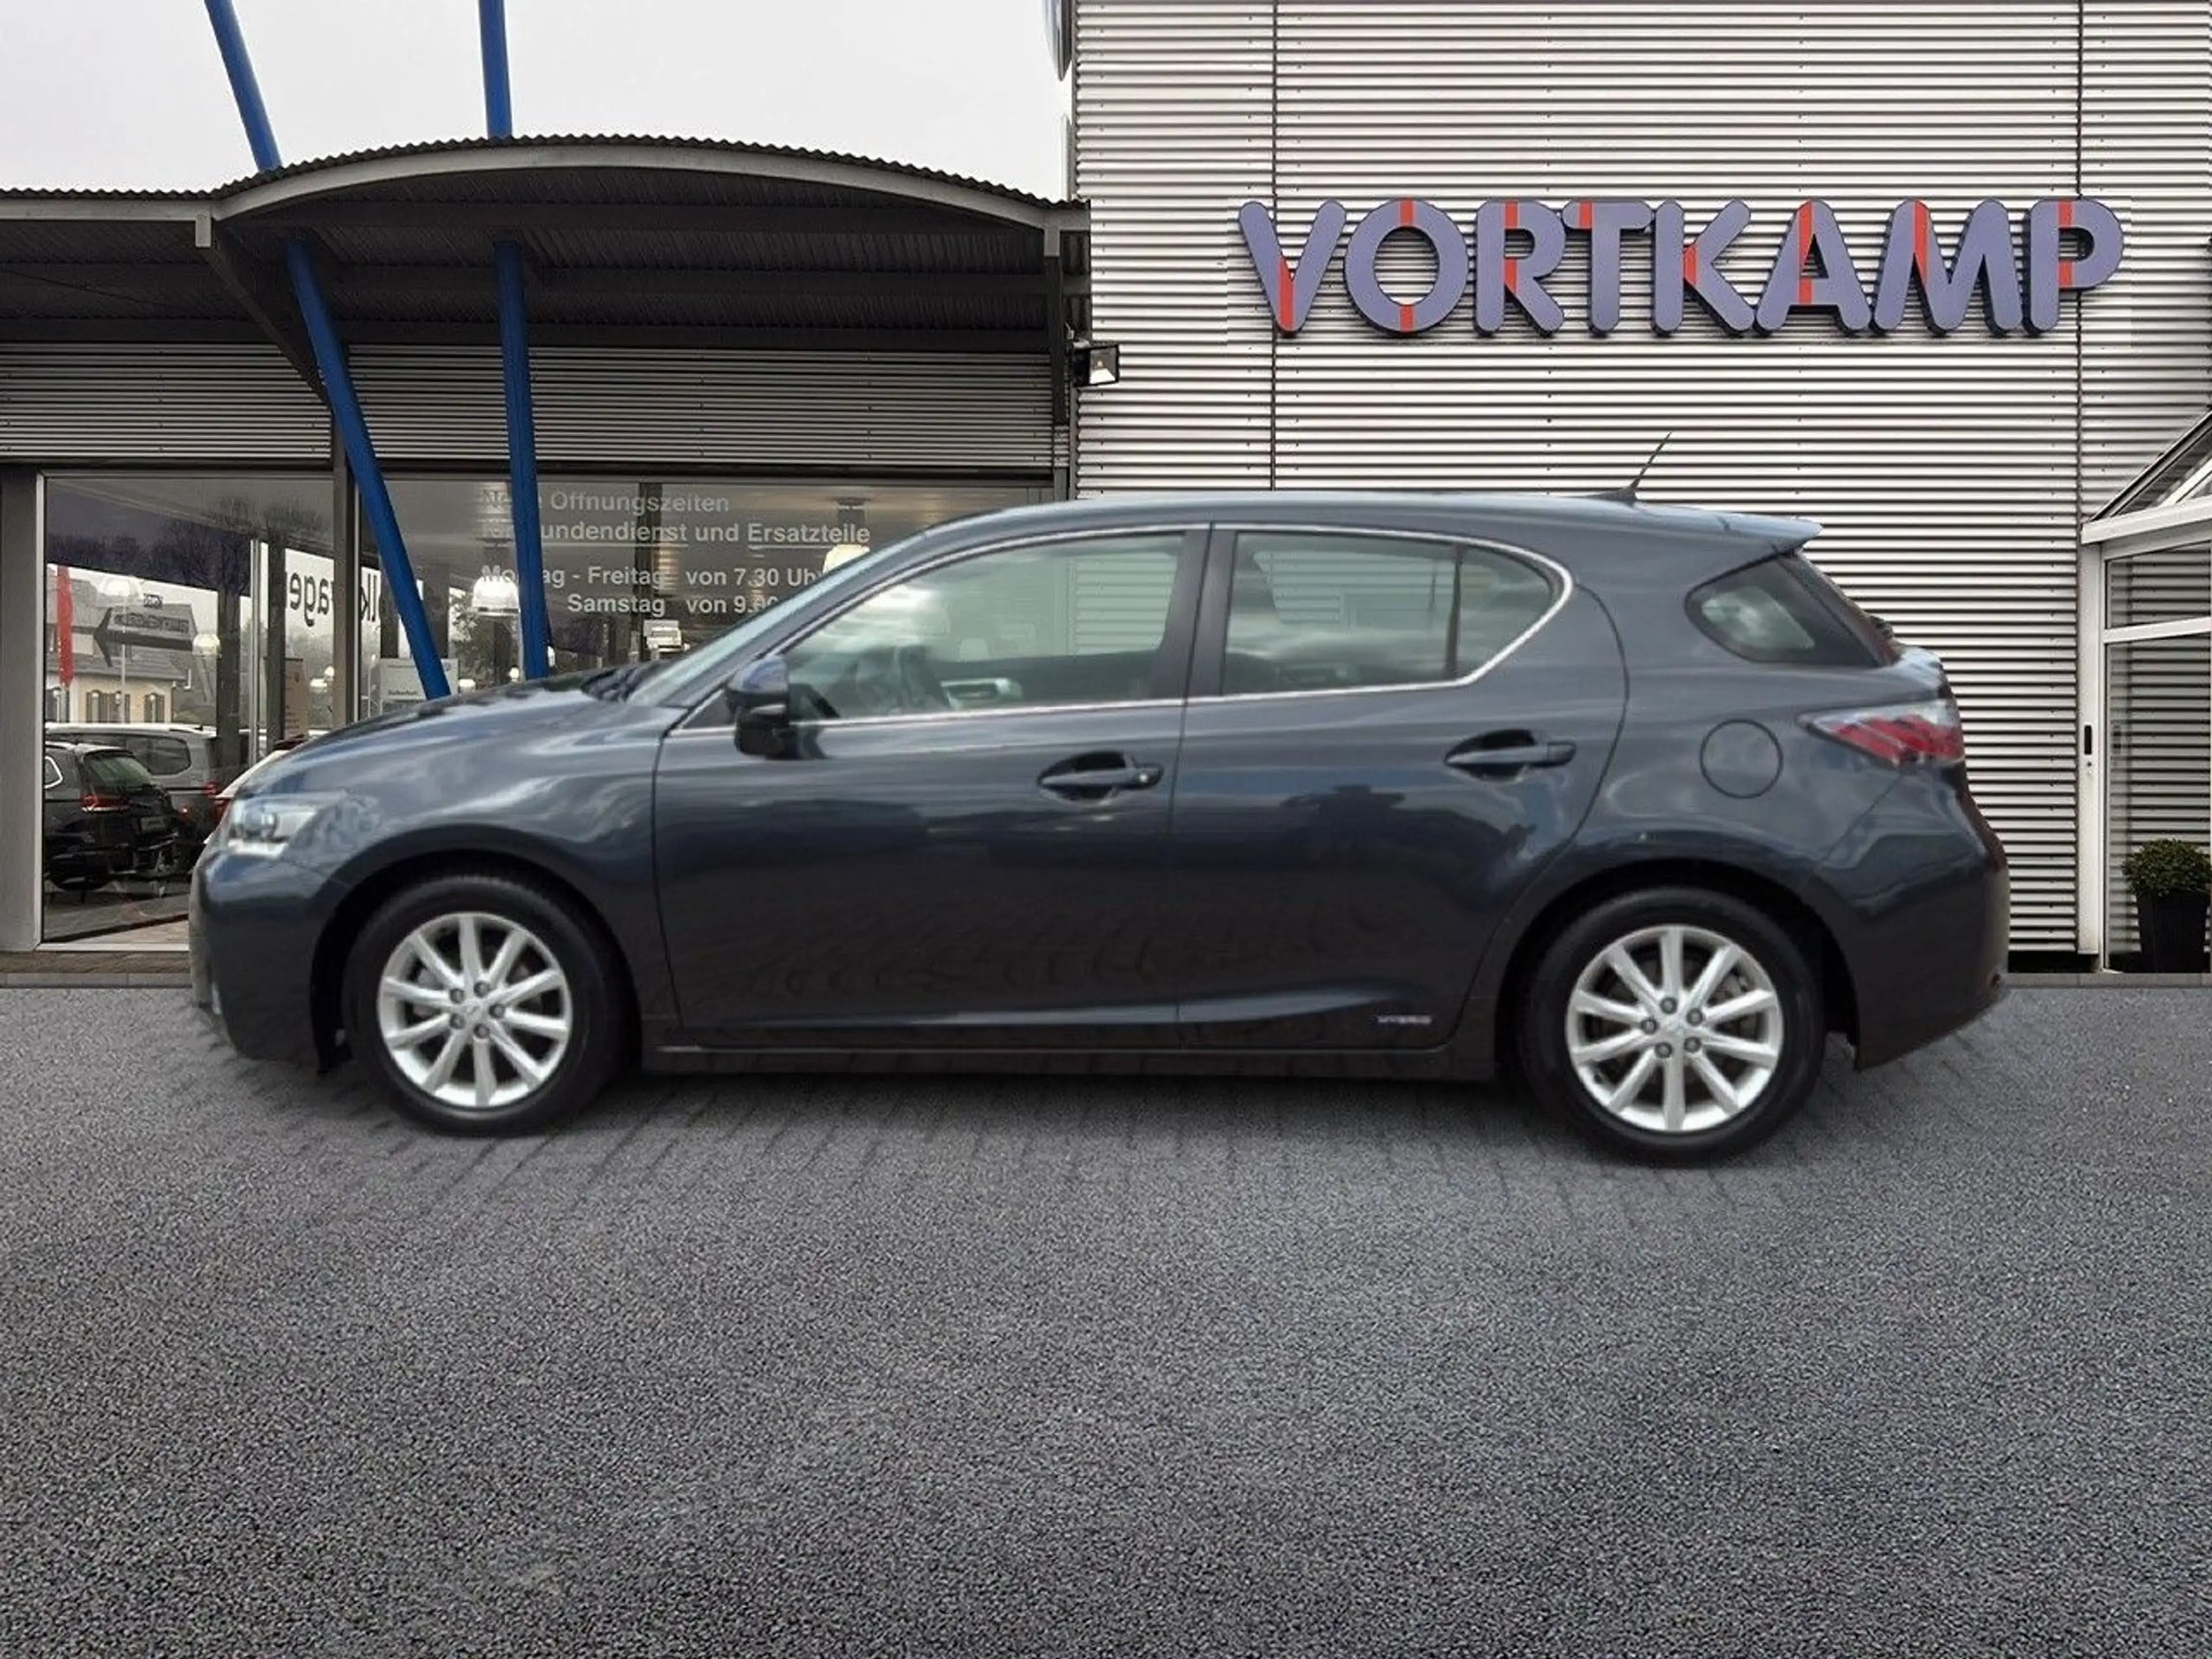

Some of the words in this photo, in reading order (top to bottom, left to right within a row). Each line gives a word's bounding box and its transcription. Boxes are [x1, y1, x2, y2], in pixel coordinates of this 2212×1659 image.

[1238, 199, 2124, 336] VORTKAMP
[540, 521, 687, 541] undendienst
[695, 523, 739, 541] und
[748, 523, 871, 543] Ersatzteile
[482, 565, 566, 588] Moag
[587, 566, 663, 590] Freitag
[685, 571, 727, 586] von
[567, 593, 665, 618] Samstag
[685, 599, 727, 613] von
